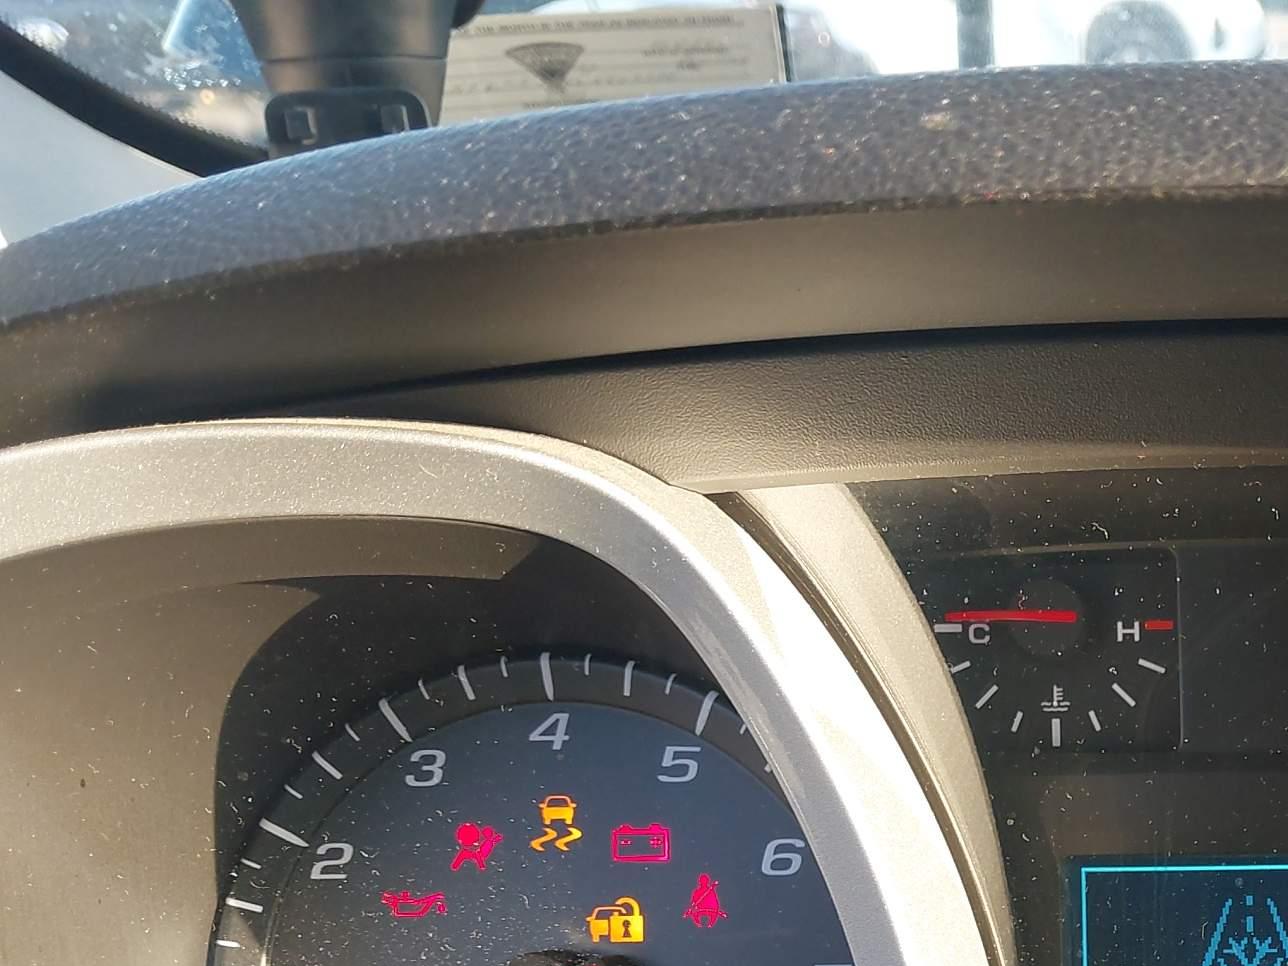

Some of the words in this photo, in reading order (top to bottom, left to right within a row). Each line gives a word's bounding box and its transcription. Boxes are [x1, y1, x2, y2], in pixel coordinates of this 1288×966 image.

[967, 622, 992, 644] C
[1116, 620, 1140, 642] H
[529, 712, 571, 751] 4
[405, 749, 446, 788] 3
[657, 745, 700, 783] 5
[310, 842, 354, 880] 2
[761, 838, 806, 876] 6
